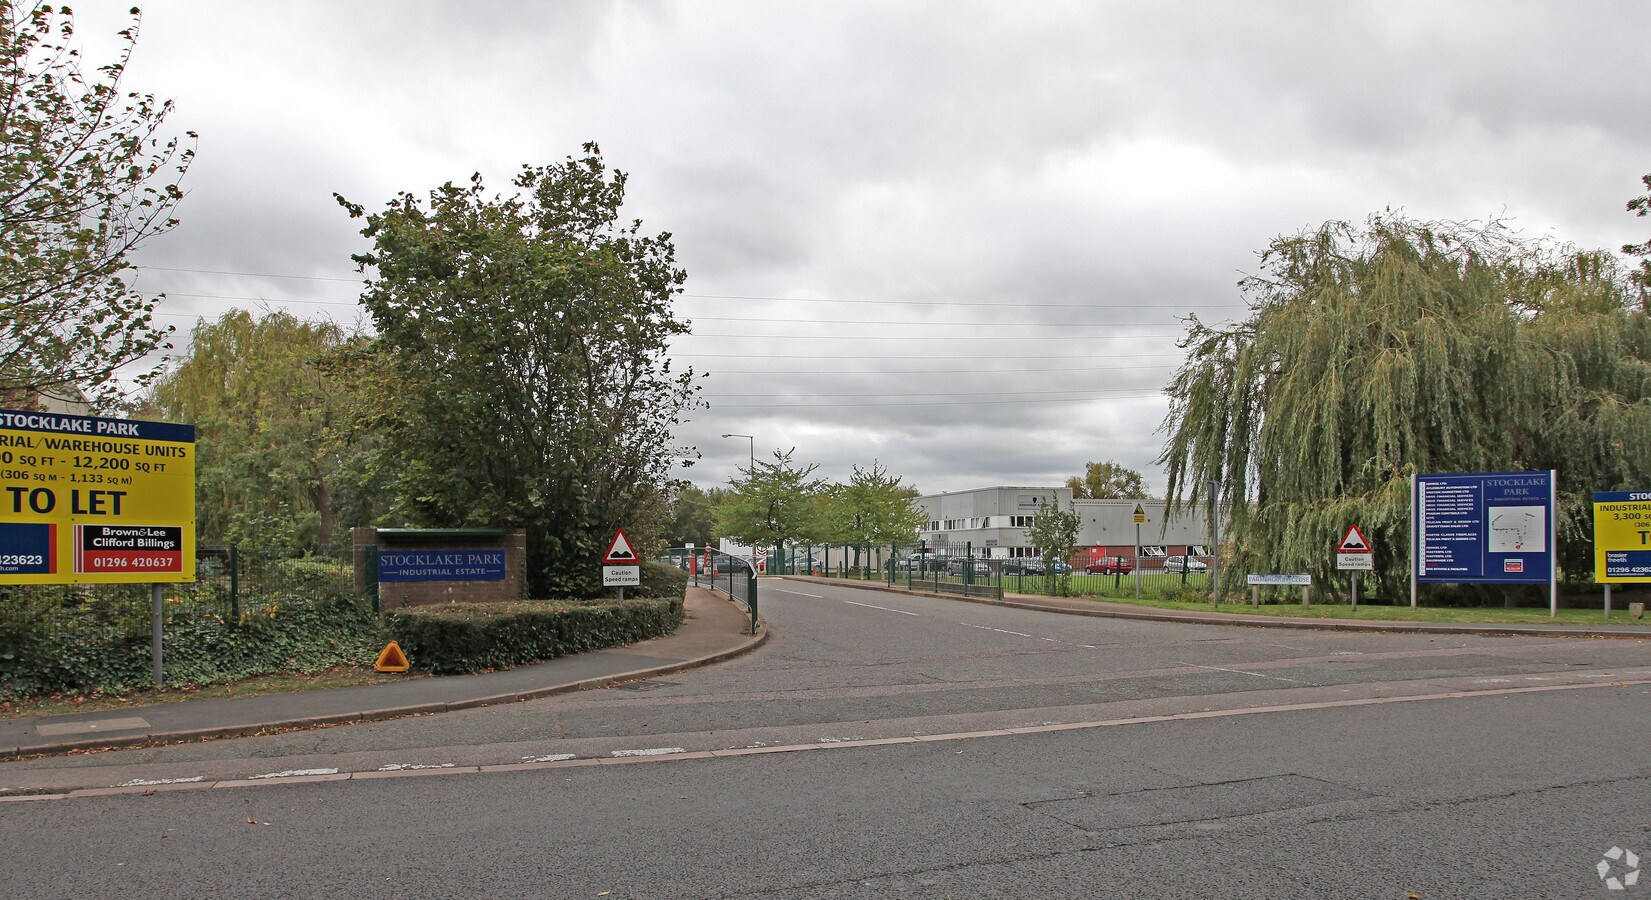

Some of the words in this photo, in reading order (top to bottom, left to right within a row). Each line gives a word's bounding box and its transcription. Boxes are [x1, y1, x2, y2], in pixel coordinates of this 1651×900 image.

[97, 421, 139, 436] PARK
[0, 434, 140, 455] RIAL/WAREHOUSE
[145, 445, 186, 458] UNITS
[19, 455, 37, 467] SQ
[41, 457, 55, 466] FT
[73, 456, 130, 470] 12,200
[135, 462, 150, 473] SQ
[154, 463, 166, 472] FT
[1, 469, 29, 480] (306
[33, 473, 46, 481] SQ
[70, 473, 103, 483] 1,133
[107, 477, 119, 485] SQ
[121, 476, 133, 485] M)
[1487, 478, 1546, 487] STOCKLAKE
[1504, 488, 1529, 496] PARK
[6, 486, 56, 514] TO
[71, 489, 127, 515] LET
[102, 527, 166, 537] Brown&Lee
[93, 538, 134, 547] Clifford
[137, 538, 175, 550] Billings
[0, 555, 43, 565] 23623
[94, 557, 128, 567] 01296
[131, 557, 173, 567] 420637
[380, 554, 463, 566] STOCKLAKE
[468, 554, 502, 565] PARK
[399, 568, 452, 576] INDUSTRIAL
